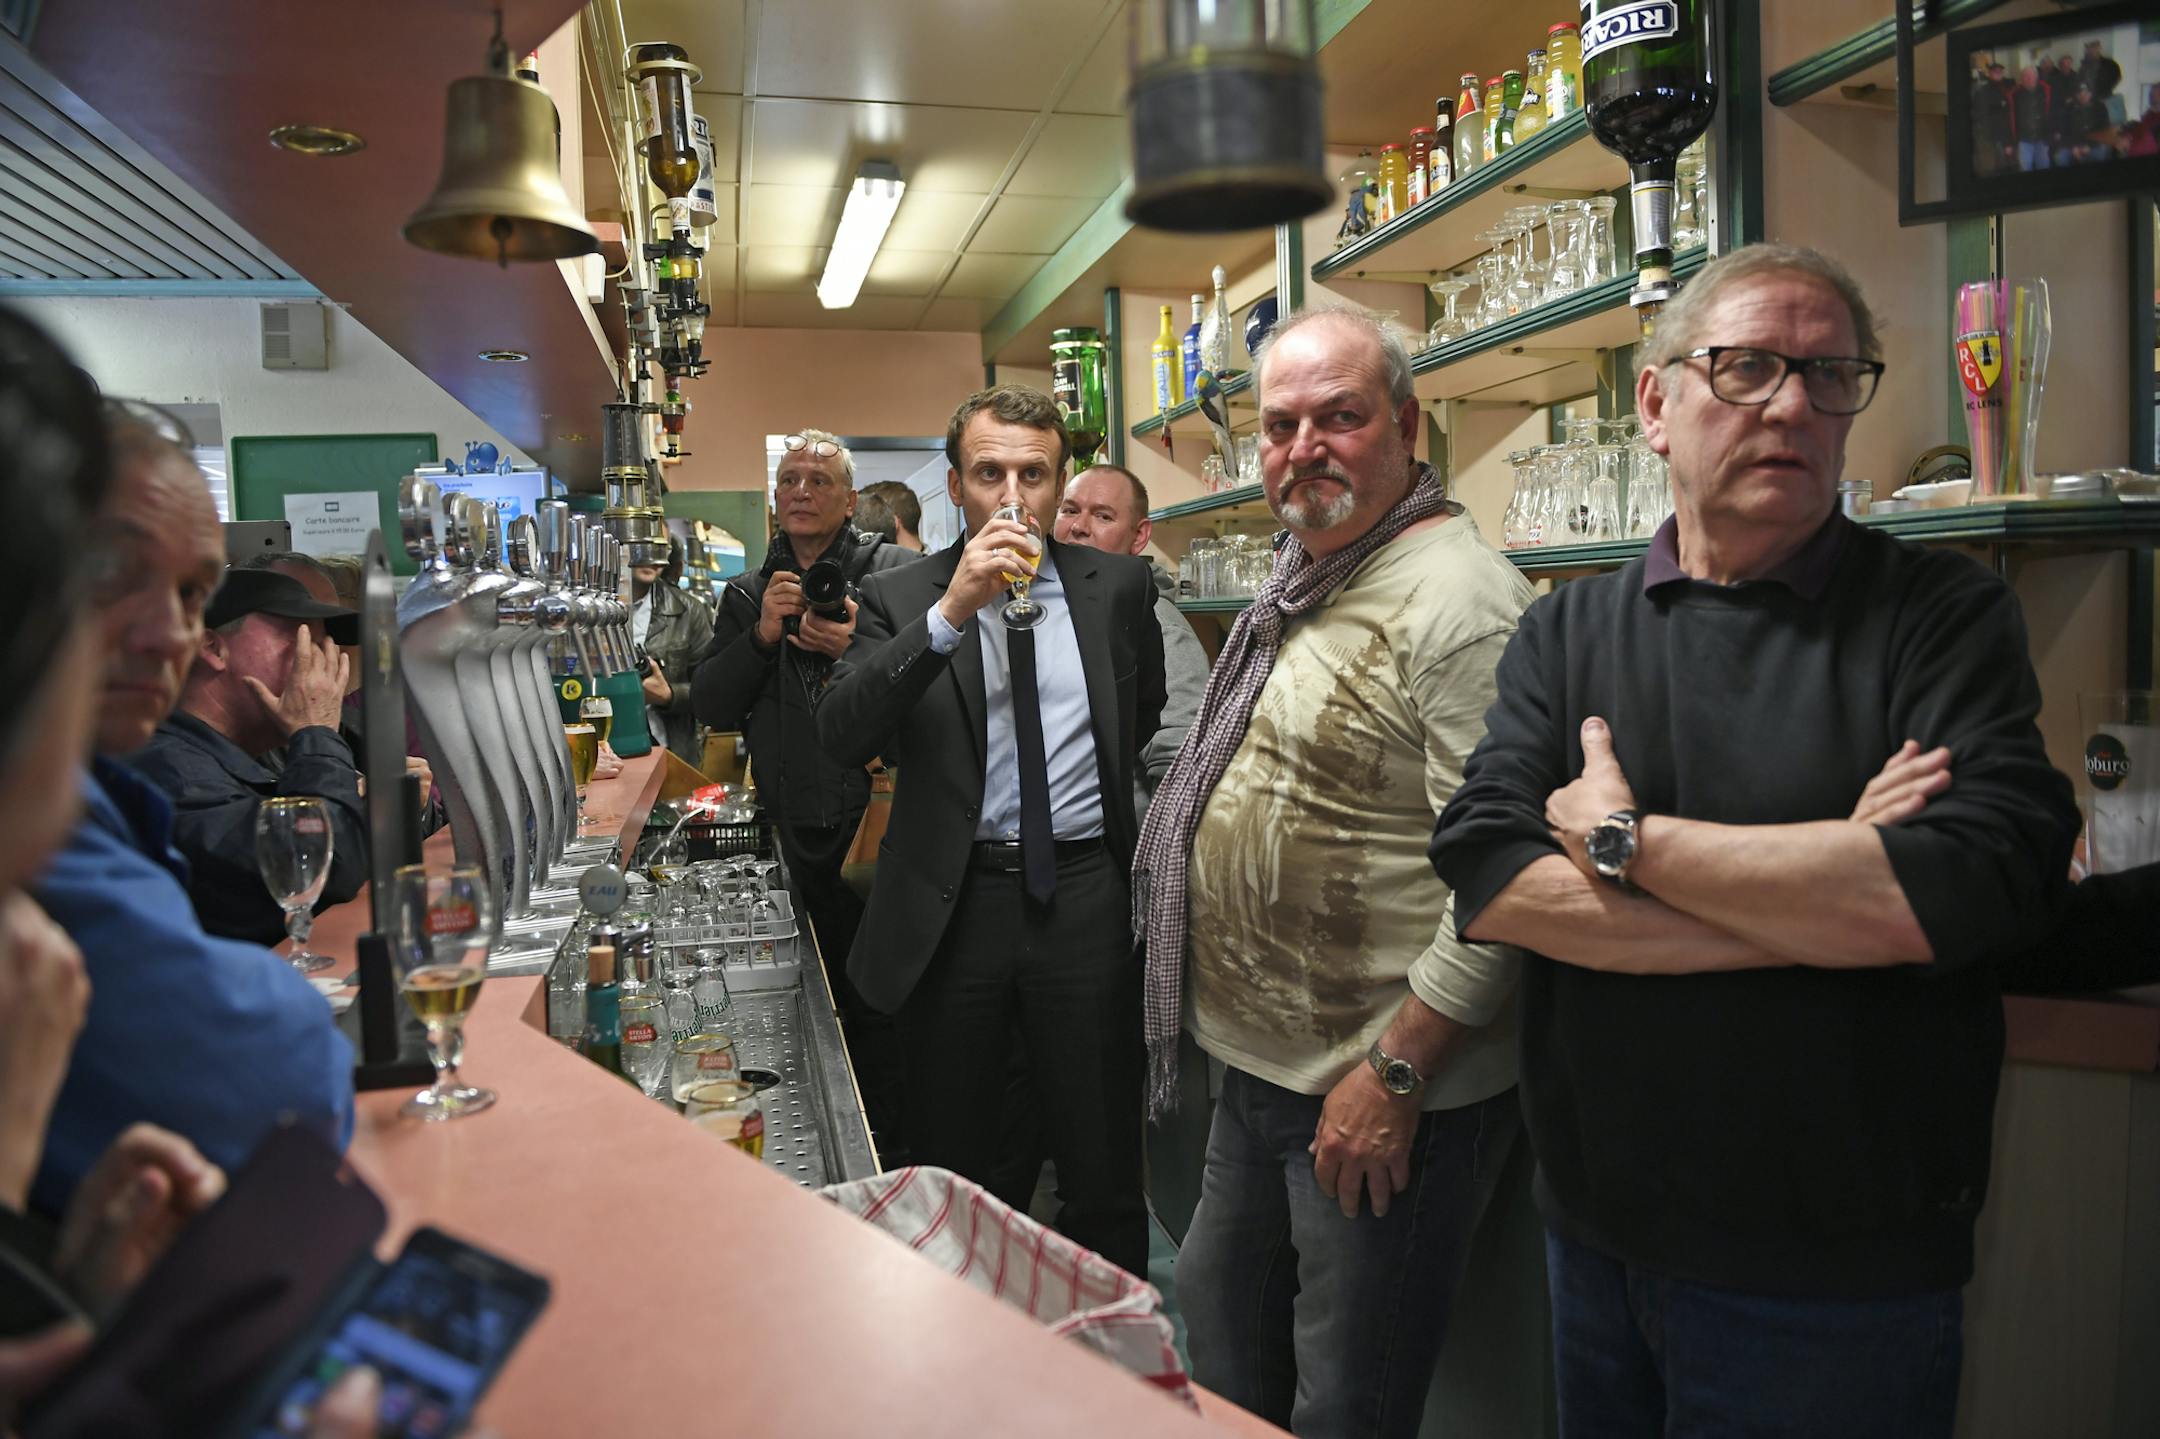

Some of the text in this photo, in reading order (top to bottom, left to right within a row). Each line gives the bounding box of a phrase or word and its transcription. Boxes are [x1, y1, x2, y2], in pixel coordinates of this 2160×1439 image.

[1582, 8, 1665, 51] RICAR
[305, 516, 360, 525] Carte bancaire
[588, 886, 617, 897] EAU
